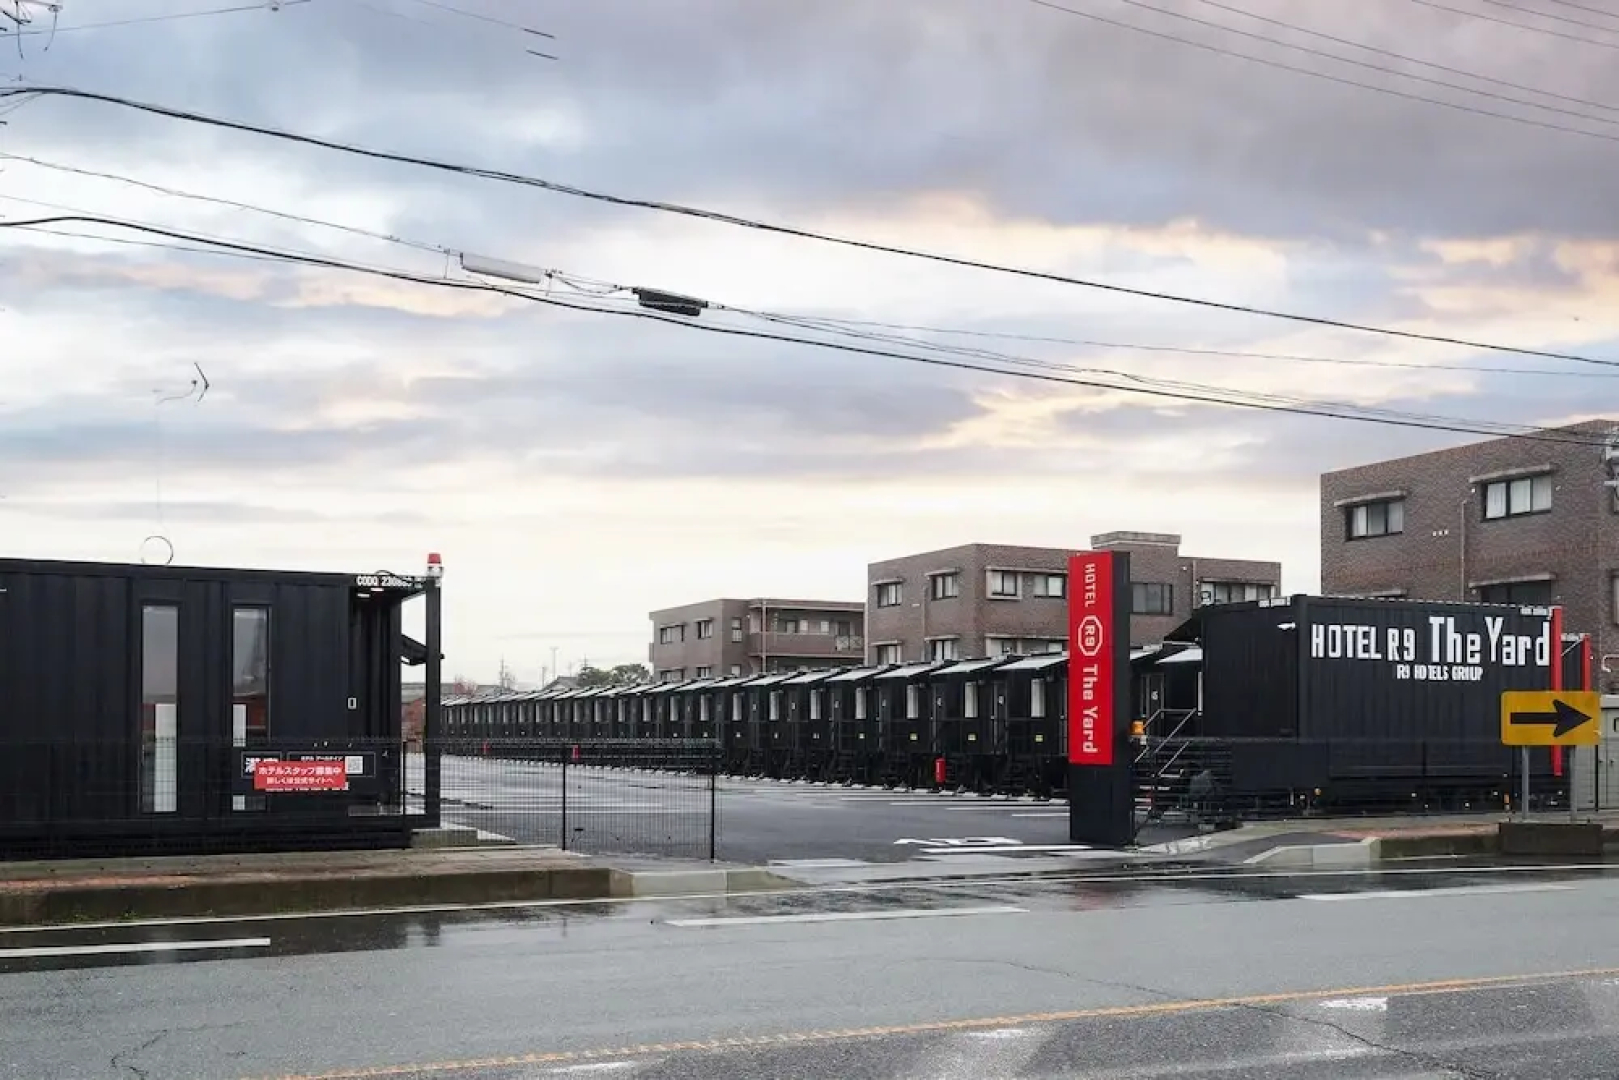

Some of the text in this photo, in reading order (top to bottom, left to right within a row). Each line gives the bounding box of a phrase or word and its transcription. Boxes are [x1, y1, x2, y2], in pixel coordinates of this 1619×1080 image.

[1083, 563, 1098, 753] HOTEL R9 The Yard
[1311, 616, 1549, 666] HOTEL R9 The Yard
[1414, 664, 1449, 681] HOTELS
